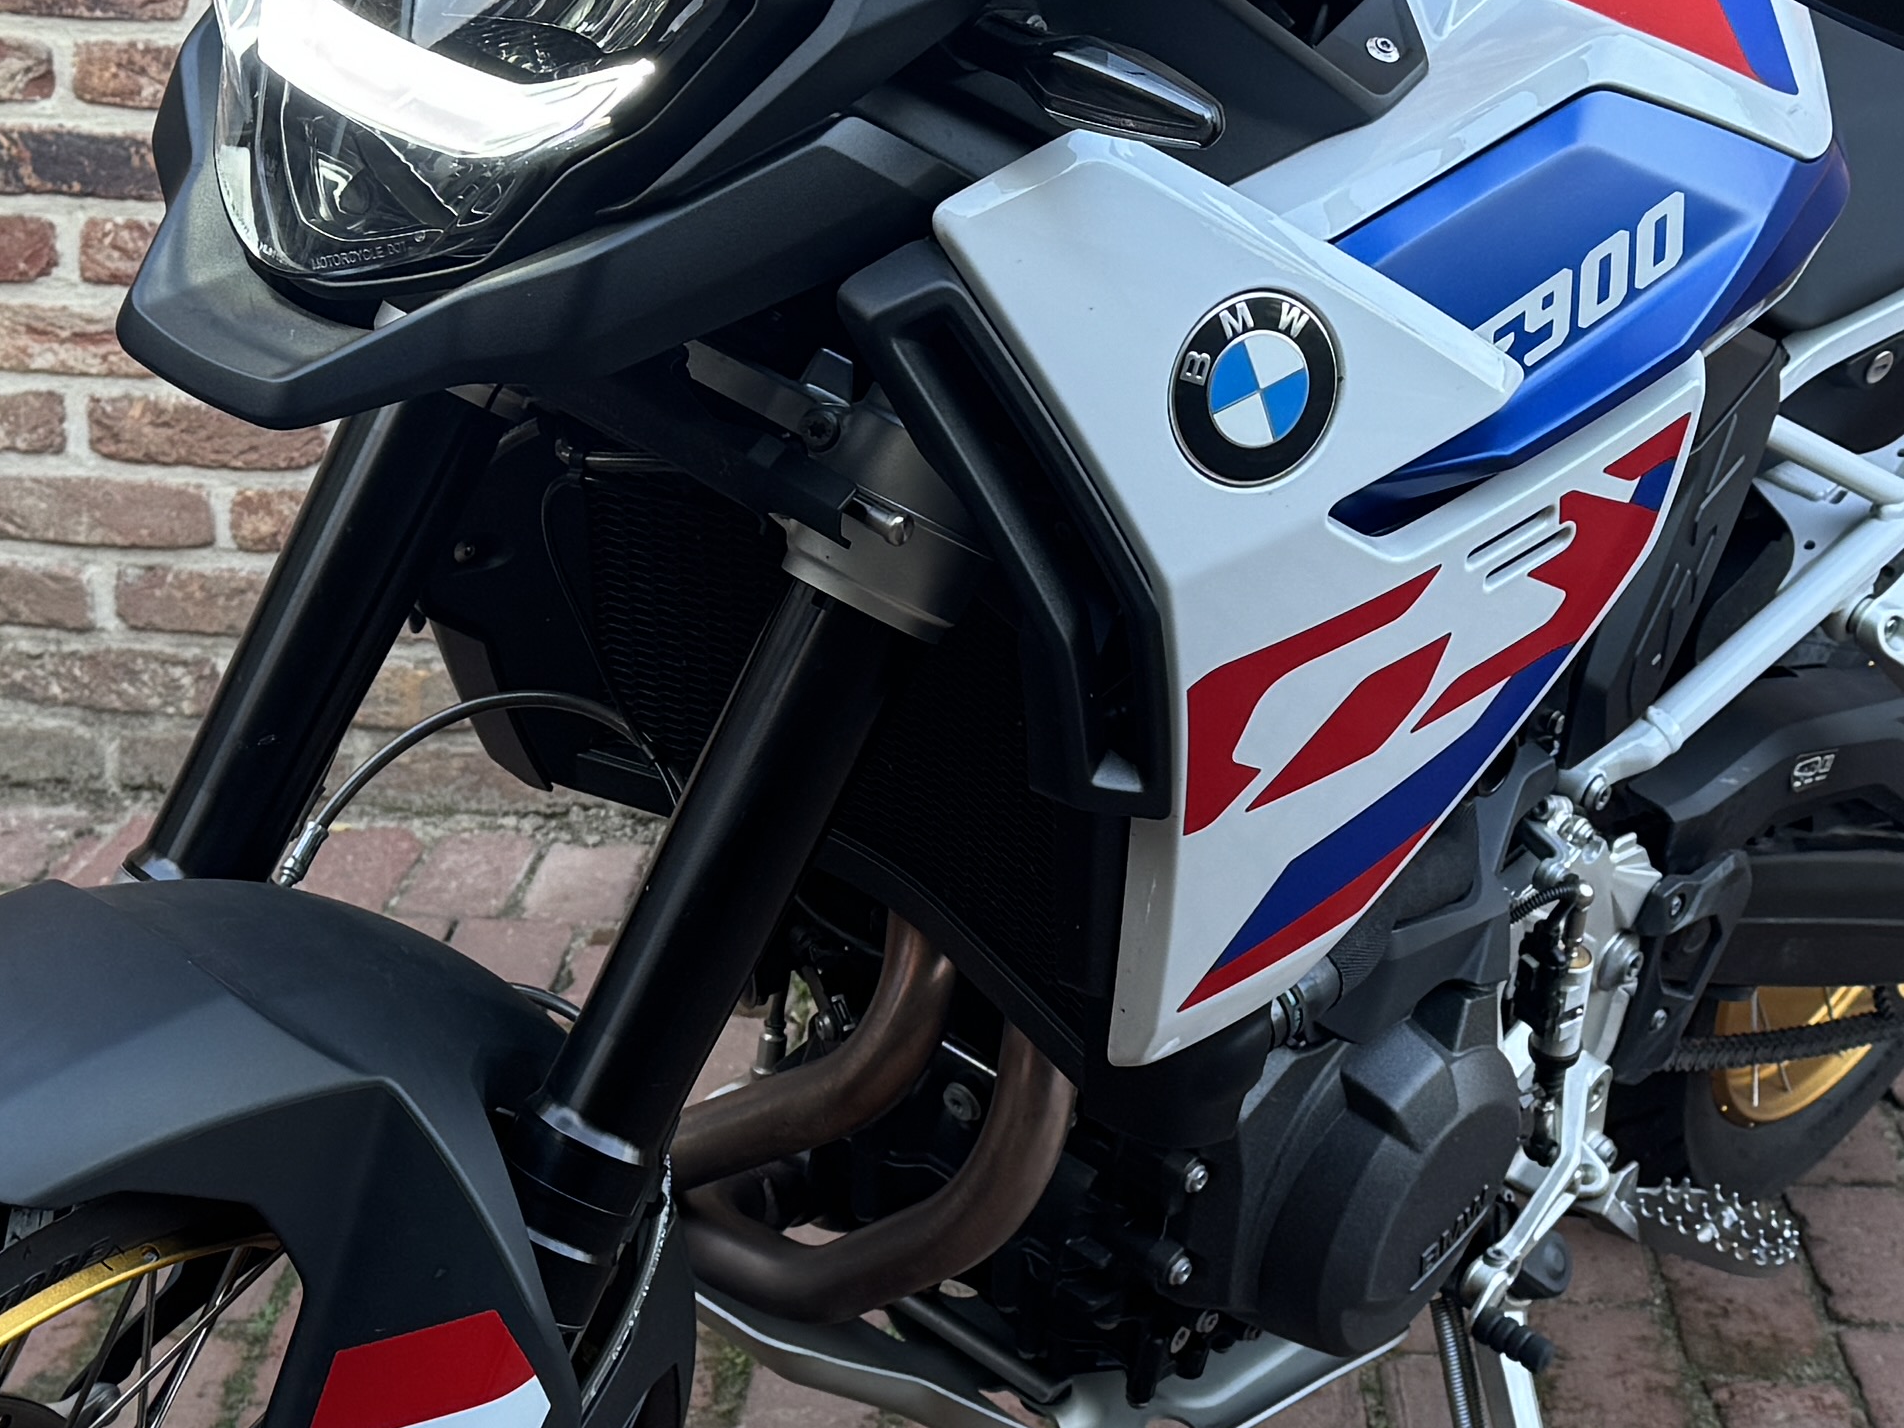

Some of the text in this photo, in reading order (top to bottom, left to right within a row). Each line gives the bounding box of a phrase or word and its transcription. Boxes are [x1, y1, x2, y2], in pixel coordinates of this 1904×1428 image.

[310, 245, 385, 271] MOTORCYCLE
[1178, 300, 1311, 388] BMW
[1418, 1182, 1490, 1280] BMW
